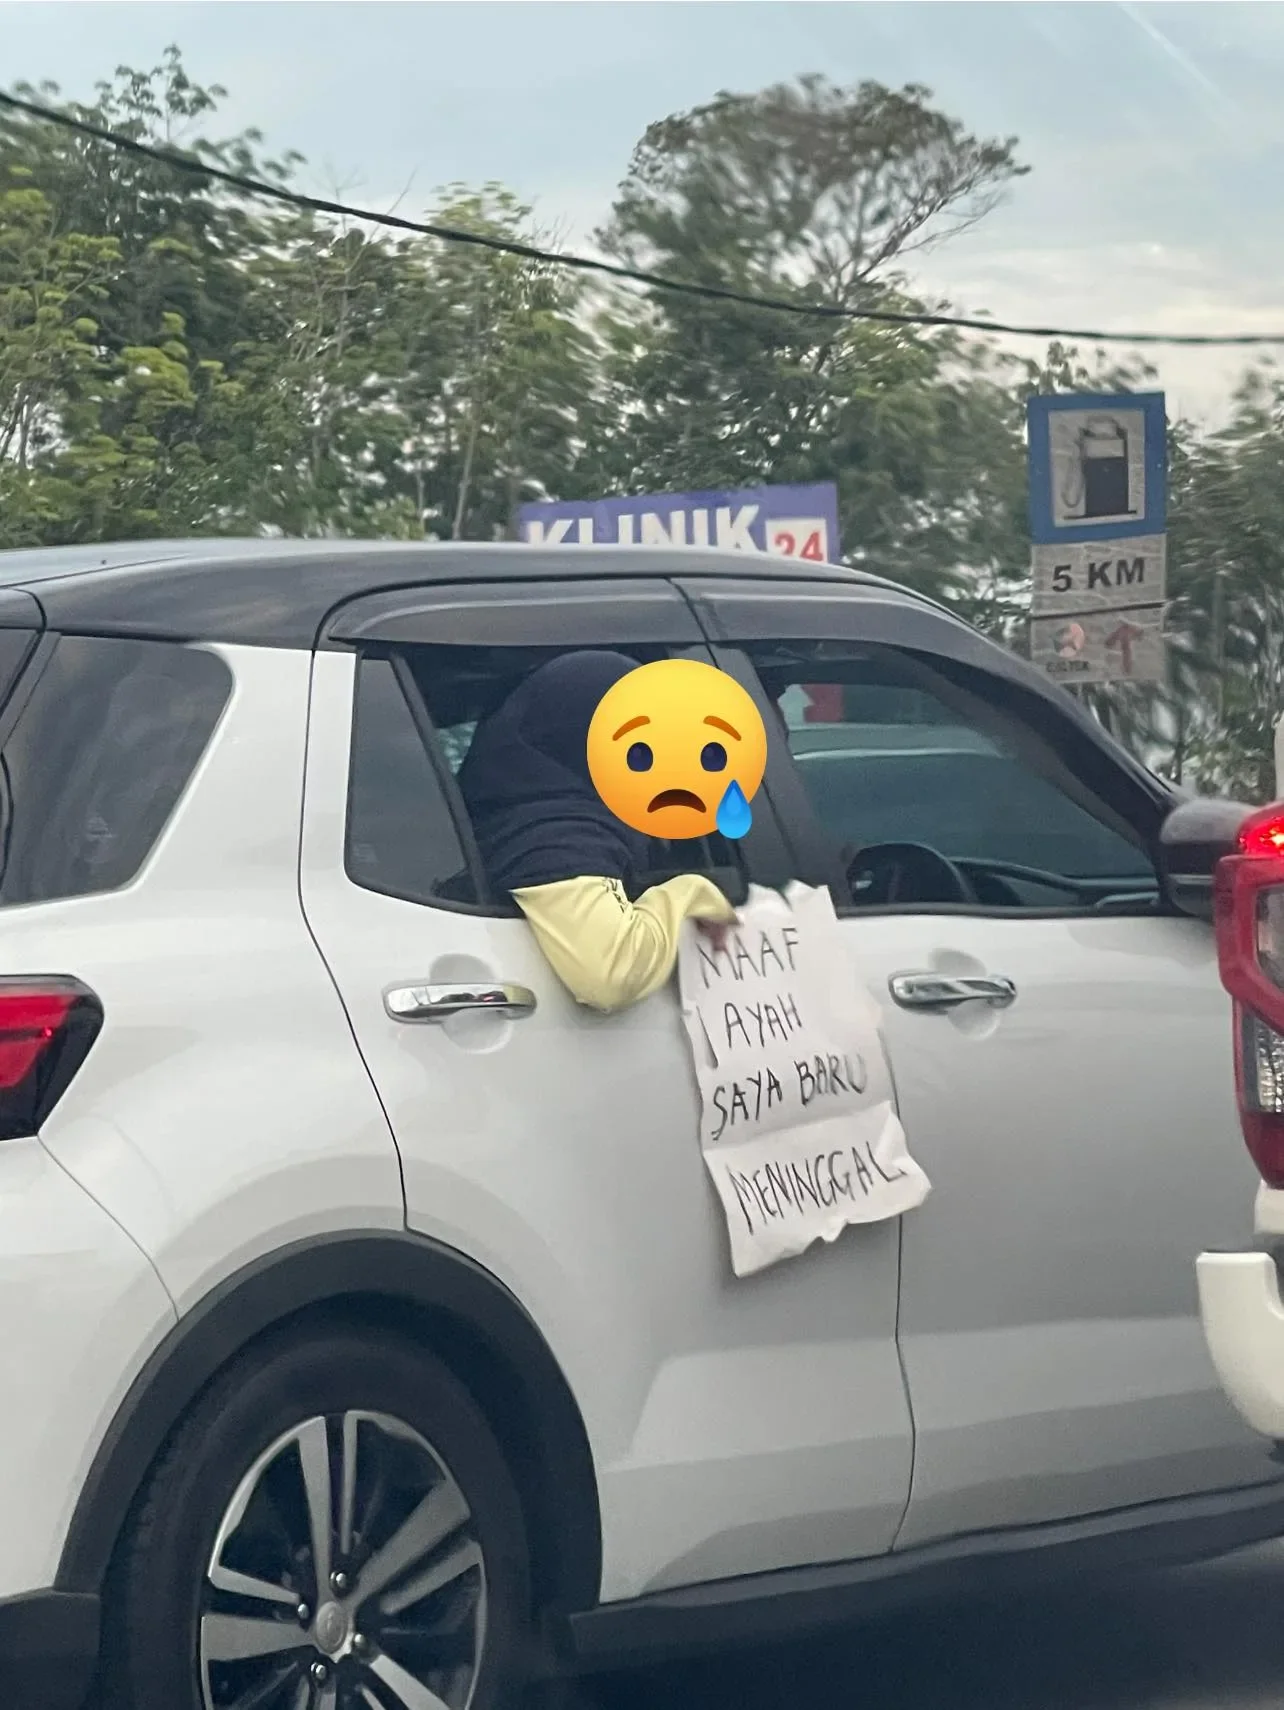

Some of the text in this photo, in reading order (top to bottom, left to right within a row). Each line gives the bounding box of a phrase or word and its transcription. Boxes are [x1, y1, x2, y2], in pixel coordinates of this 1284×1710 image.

[774, 530, 823, 562] 24
[1052, 556, 1146, 592] 5 KM
[695, 926, 799, 989] MAAF
[725, 993, 802, 1050] AYAH
[711, 1052, 868, 1141] SAYA BARU
[725, 1141, 908, 1236] MENINGGAL
